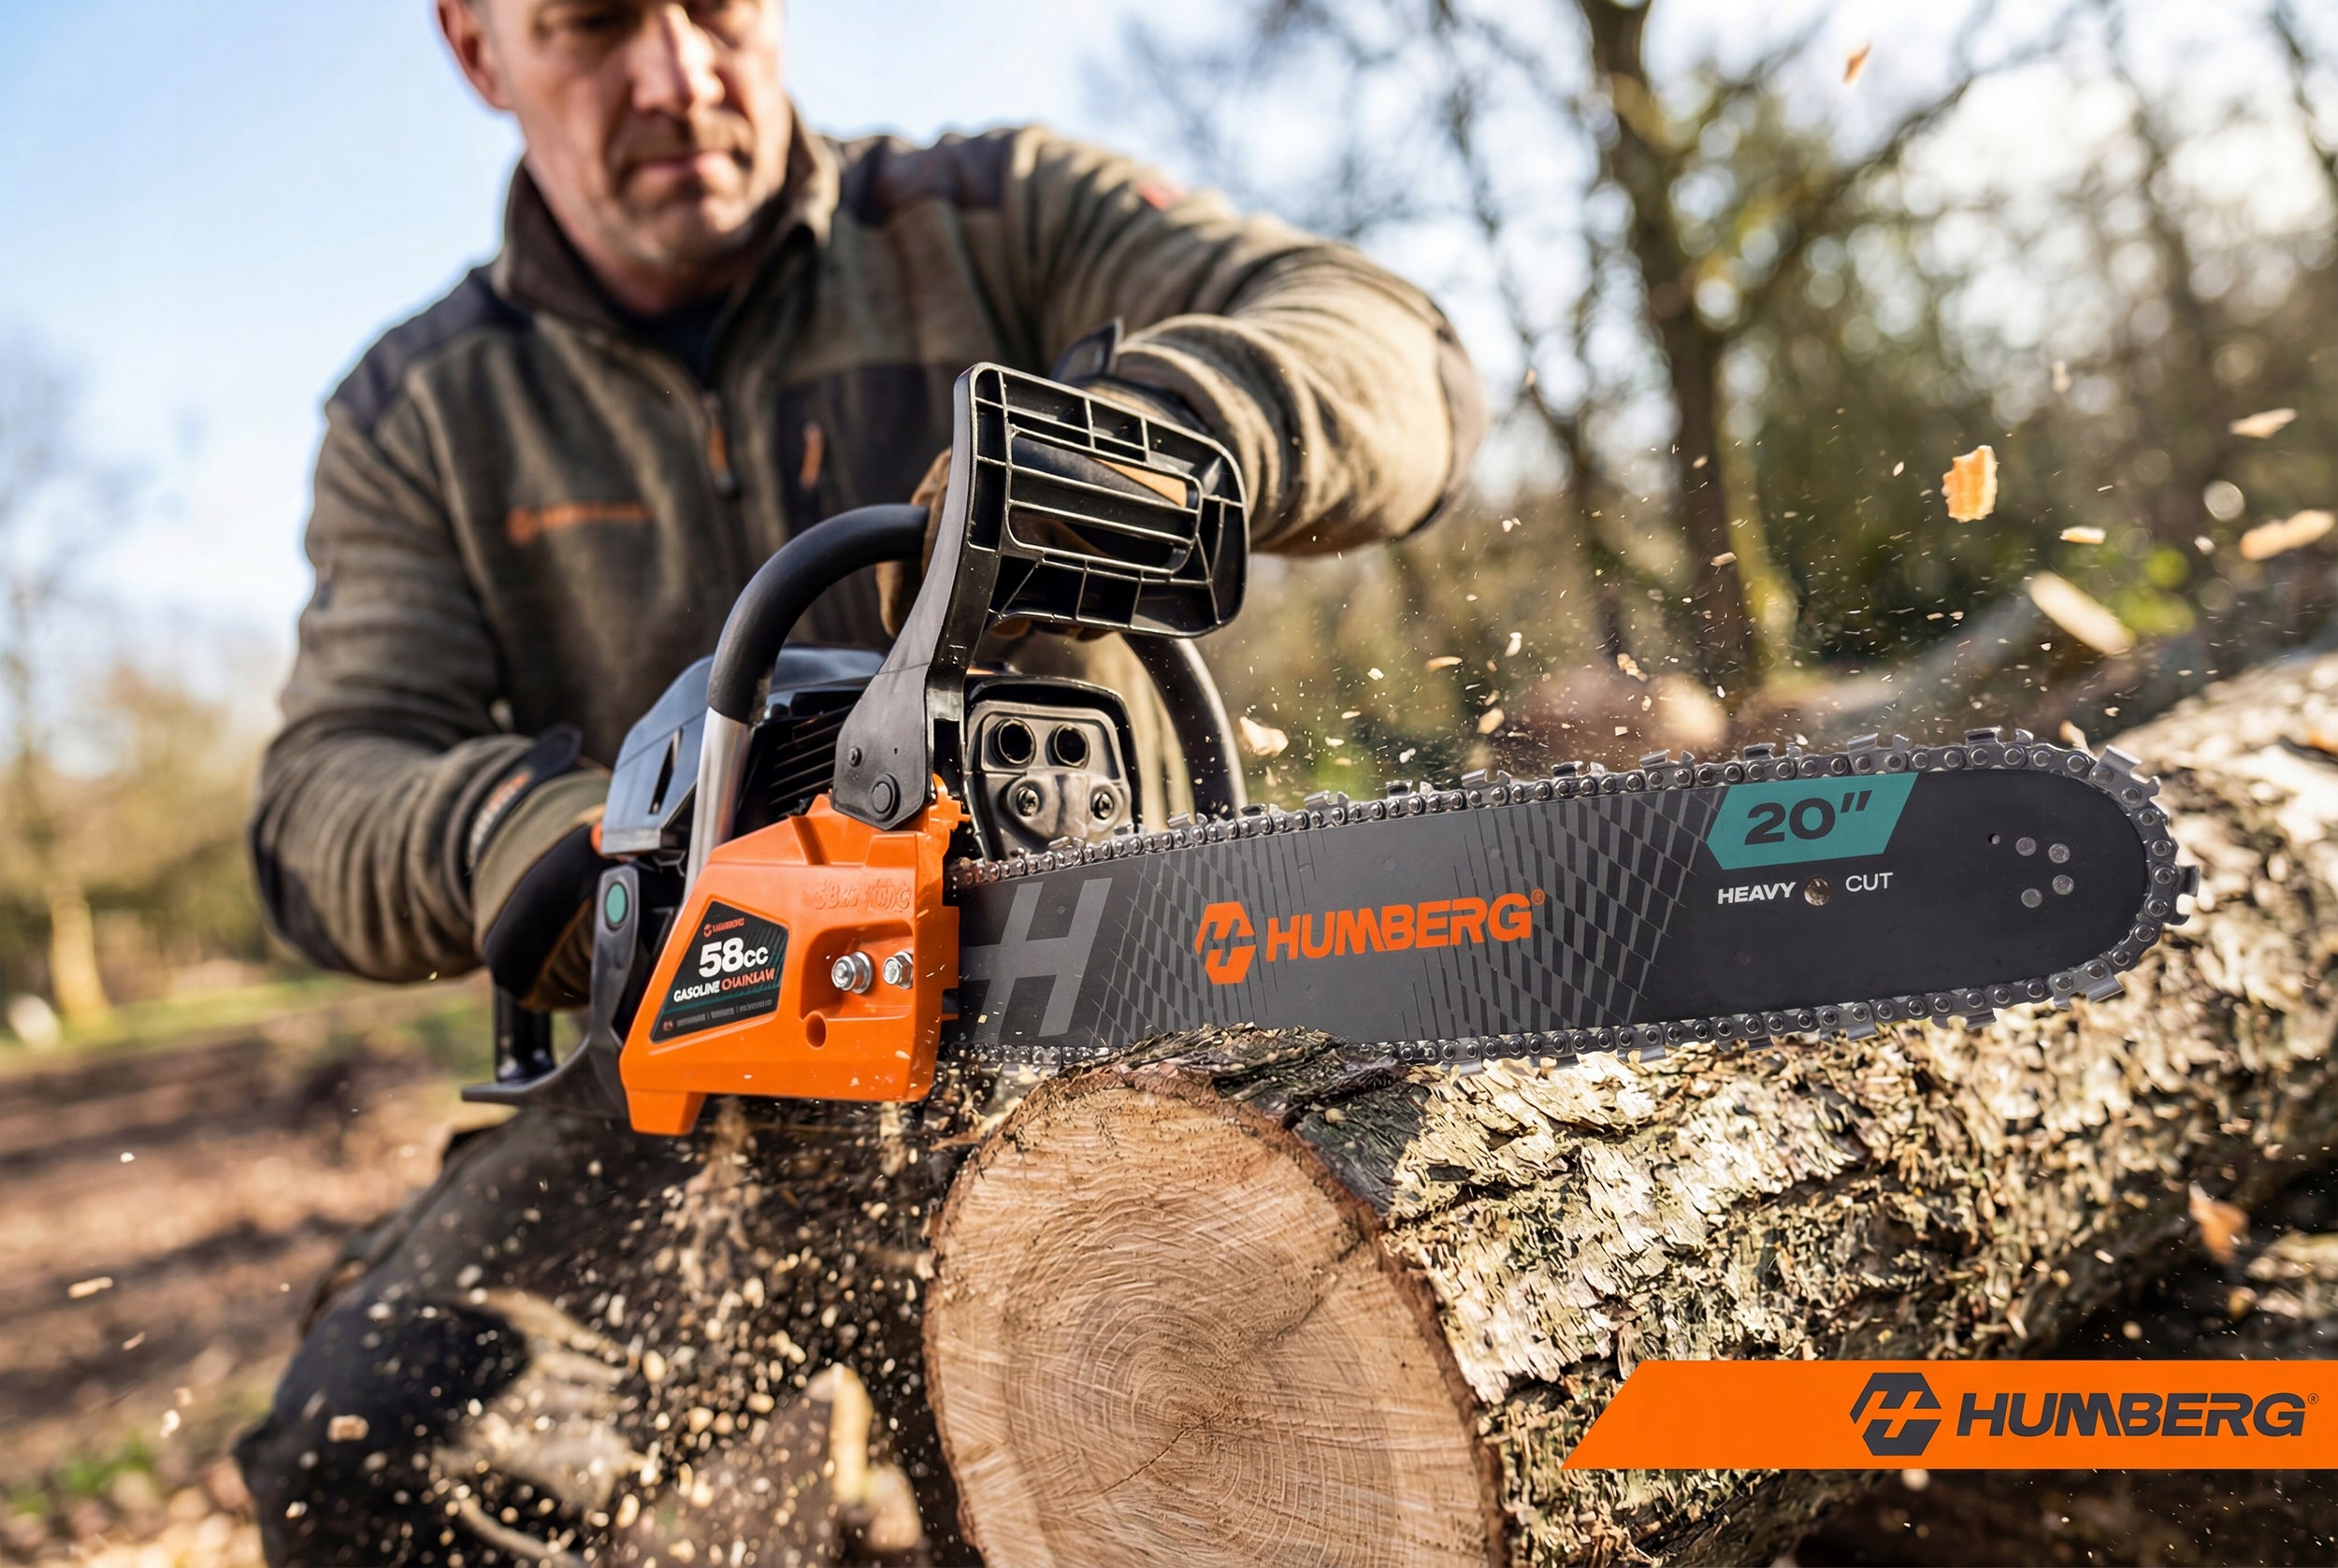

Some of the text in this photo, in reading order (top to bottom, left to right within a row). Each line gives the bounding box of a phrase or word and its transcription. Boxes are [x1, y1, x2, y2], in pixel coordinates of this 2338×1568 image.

[1744, 789, 1872, 845] 20"
[1717, 871, 1894, 904] HEAVY CUT
[673, 979, 721, 1003] GASOLINE
